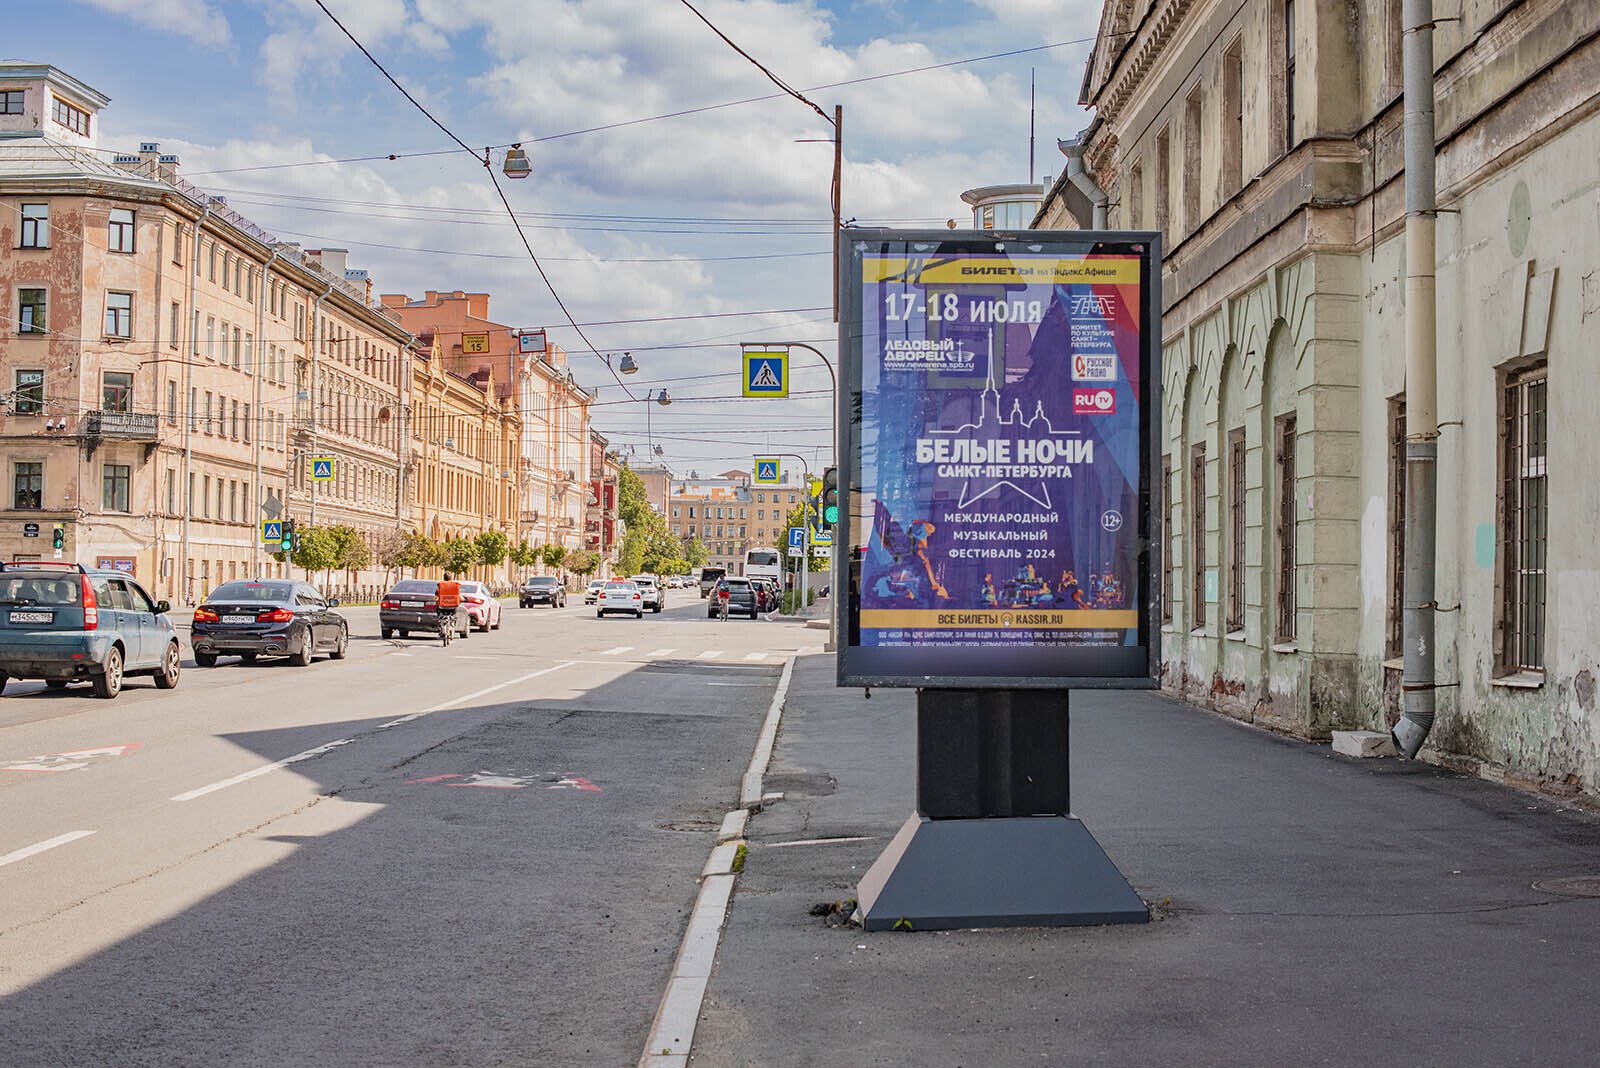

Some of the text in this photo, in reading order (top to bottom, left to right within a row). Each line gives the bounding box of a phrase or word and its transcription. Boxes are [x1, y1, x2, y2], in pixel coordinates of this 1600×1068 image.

[961, 267, 1034, 276] БИЛЕТЫ
[1050, 268, 1082, 277] Яндекс
[1084, 267, 1117, 277] Афише
[885, 293, 959, 321] 17-18
[472, 343, 482, 352] 15
[884, 338, 954, 351] ЛЕДОВЫЙ
[884, 351, 945, 362] ДВОРЕЦ
[1087, 358, 1113, 367] РУССКОЕ
[1087, 368, 1107, 377] РАДИО
[1075, 395, 1094, 405] RU
[916, 439, 1094, 464] БЕЛЫЕ НОЧИ
[937, 464, 1073, 479] САНКТ-ПЕТЕРБУРГА
[944, 511, 1059, 525] МЕЖДУНАРОДНЫЙ
[1104, 515, 1121, 527] 12+
[953, 529, 1048, 541] МУЗЫКАЛЬНЫЙ
[948, 548, 1056, 559] ФЕСТИВАЛЬ 2024
[938, 614, 998, 624] ВСЕ БИЛЕТЫ
[1015, 614, 1063, 625] KASSIR.RU
